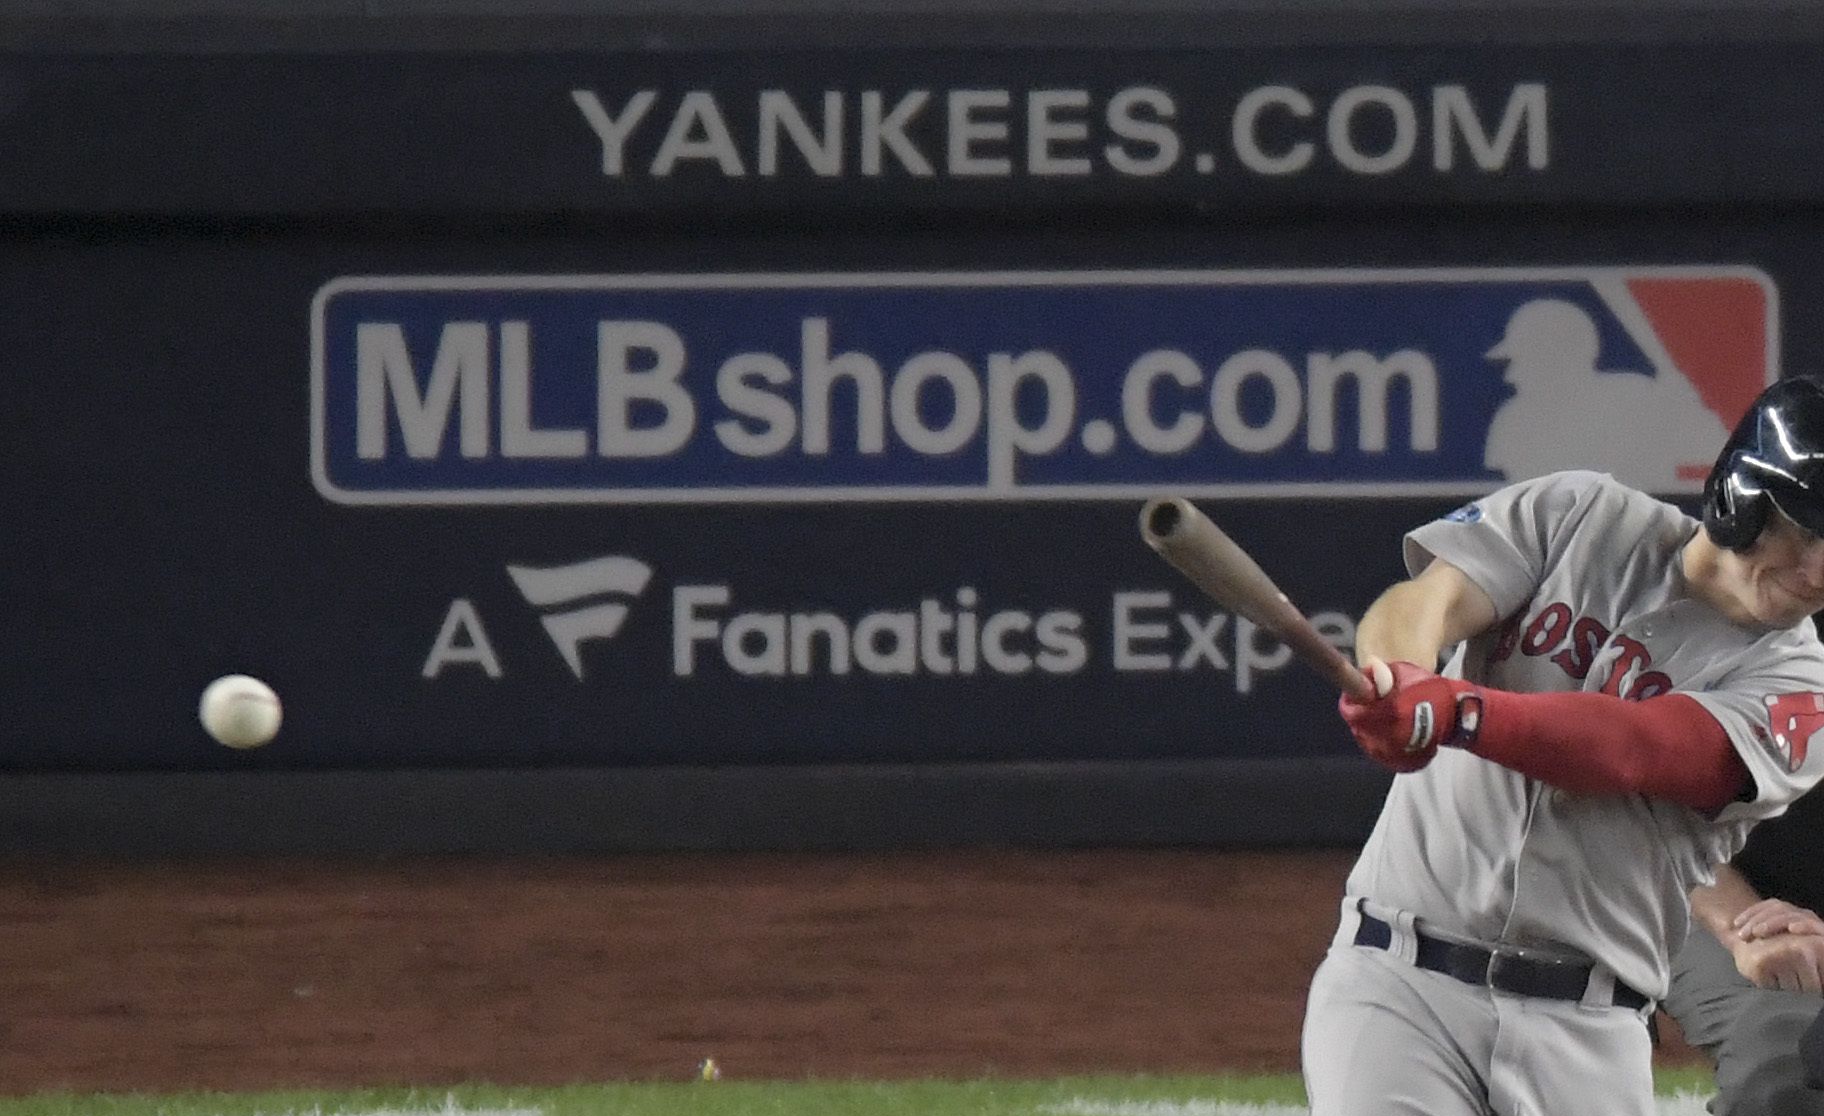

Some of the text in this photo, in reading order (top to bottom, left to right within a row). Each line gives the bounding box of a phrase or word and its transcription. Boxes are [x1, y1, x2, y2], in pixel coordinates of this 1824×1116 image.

[572, 83, 1549, 176] YANKEES.COM
[355, 316, 1439, 494] MLBshop.com
[422, 599, 503, 678] A
[672, 585, 1087, 676] Fanatics
